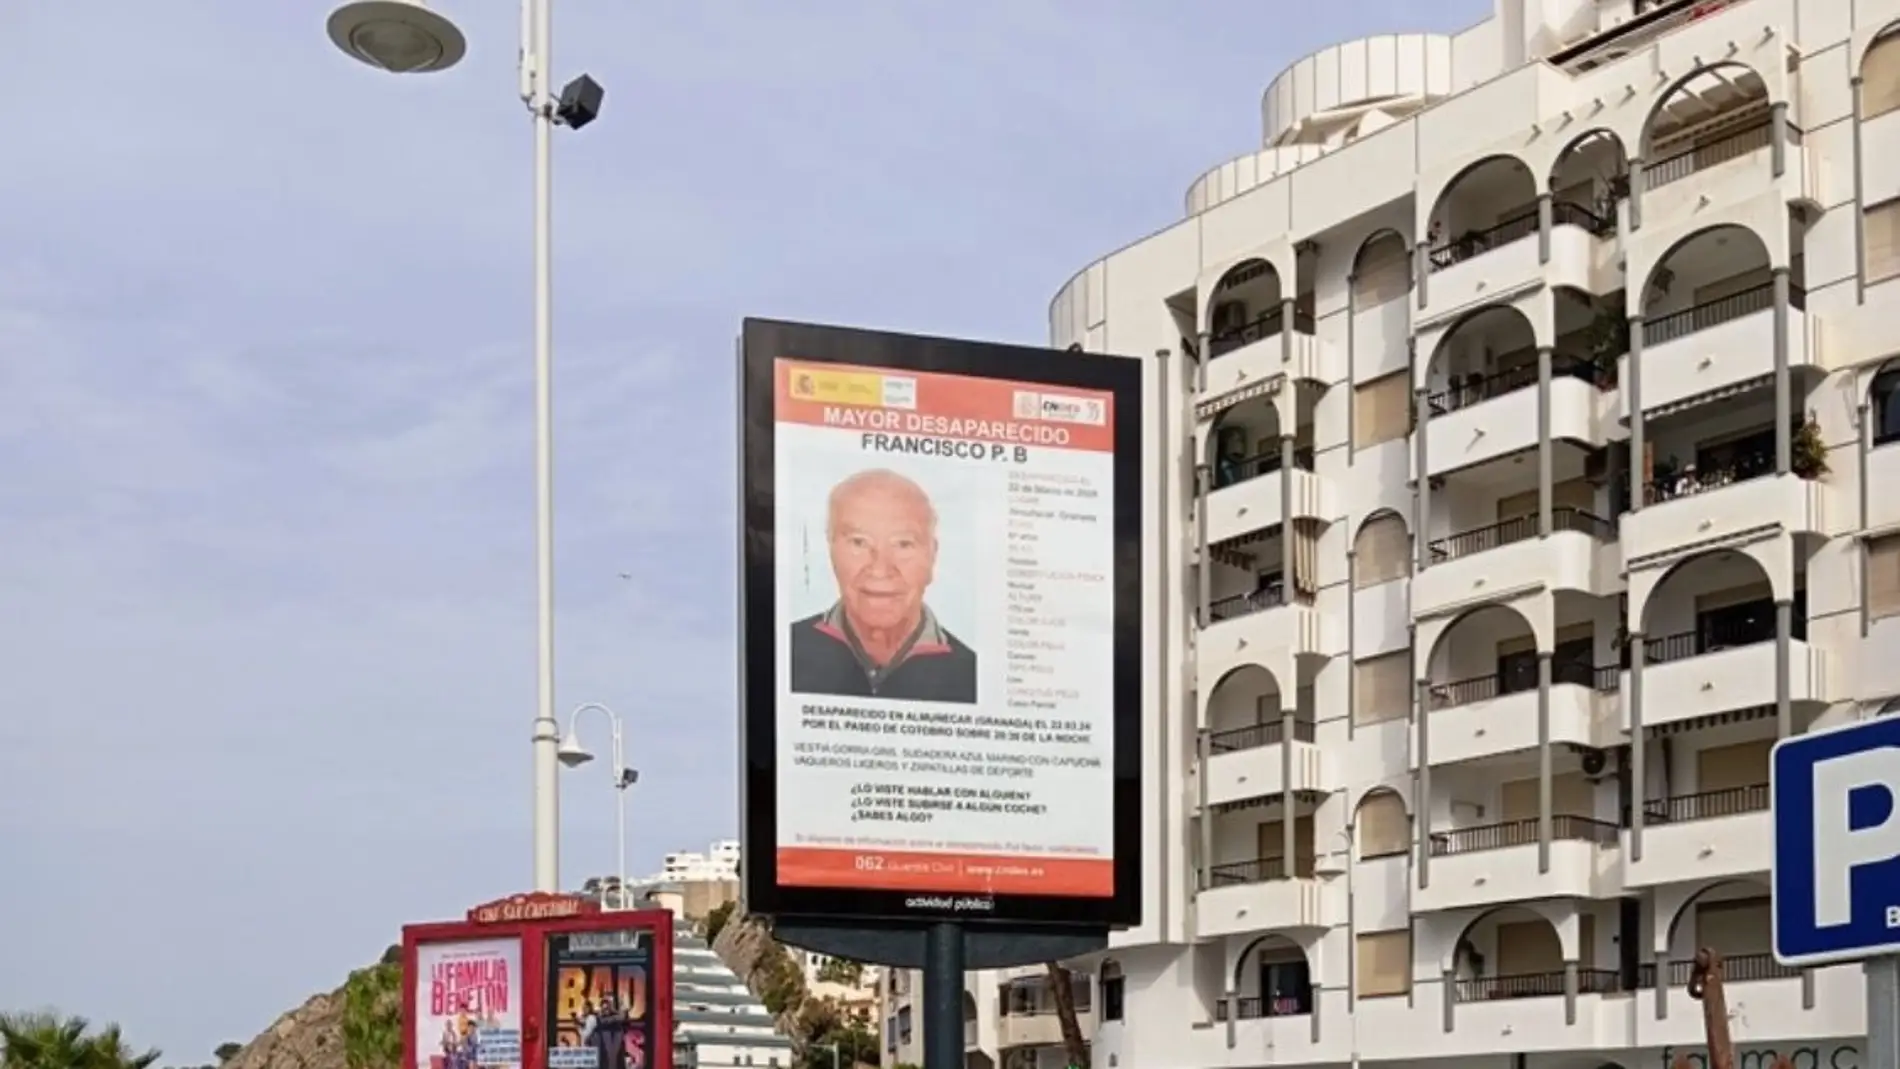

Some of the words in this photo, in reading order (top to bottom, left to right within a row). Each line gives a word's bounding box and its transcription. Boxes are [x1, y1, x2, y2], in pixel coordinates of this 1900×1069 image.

[824, 407, 900, 429] MAYOR
[906, 413, 1070, 444] DESAPARECIDO
[862, 433, 986, 459] FRANCISCO
[991, 444, 1008, 462] P.
[1014, 446, 1028, 463] B
[802, 705, 886, 720] DESAPARECIDO
[889, 710, 904, 721] EN
[1035, 719, 1047, 729] EL
[802, 719, 826, 730] POR
[829, 720, 840, 731] EL
[845, 721, 881, 733] PASEO
[883, 724, 897, 734] DE
[956, 727, 991, 739] SOBRE
[1039, 732, 1052, 743] LA
[794, 756, 851, 768] VAQUEROS
[901, 761, 908, 771] Y
[910, 762, 968, 774] ZAPATILLAS
[970, 765, 984, 776] DE
[986, 766, 1034, 778] DEPORTE
[1028, 754, 1050, 766] CON
[850, 783, 873, 795] ¿LO
[875, 784, 904, 795] VISTE
[907, 786, 951, 797] HABLAR
[954, 787, 977, 798] CON
[979, 788, 1031, 801] ALGUIEN?
[850, 796, 873, 808] ¿LO
[875, 797, 905, 808] VISTE
[908, 799, 953, 810] SUBIRSE
[955, 801, 963, 811] A
[1004, 802, 1046, 815] COCHE?
[850, 810, 894, 822] ¿SABES
[895, 810, 933, 823] ALGO?
[1813, 746, 1900, 929] P
[855, 855, 884, 870] 062
[445, 958, 508, 991] FAMILIA
[432, 980, 508, 1016] BENETON
[558, 966, 646, 1020] BAD
